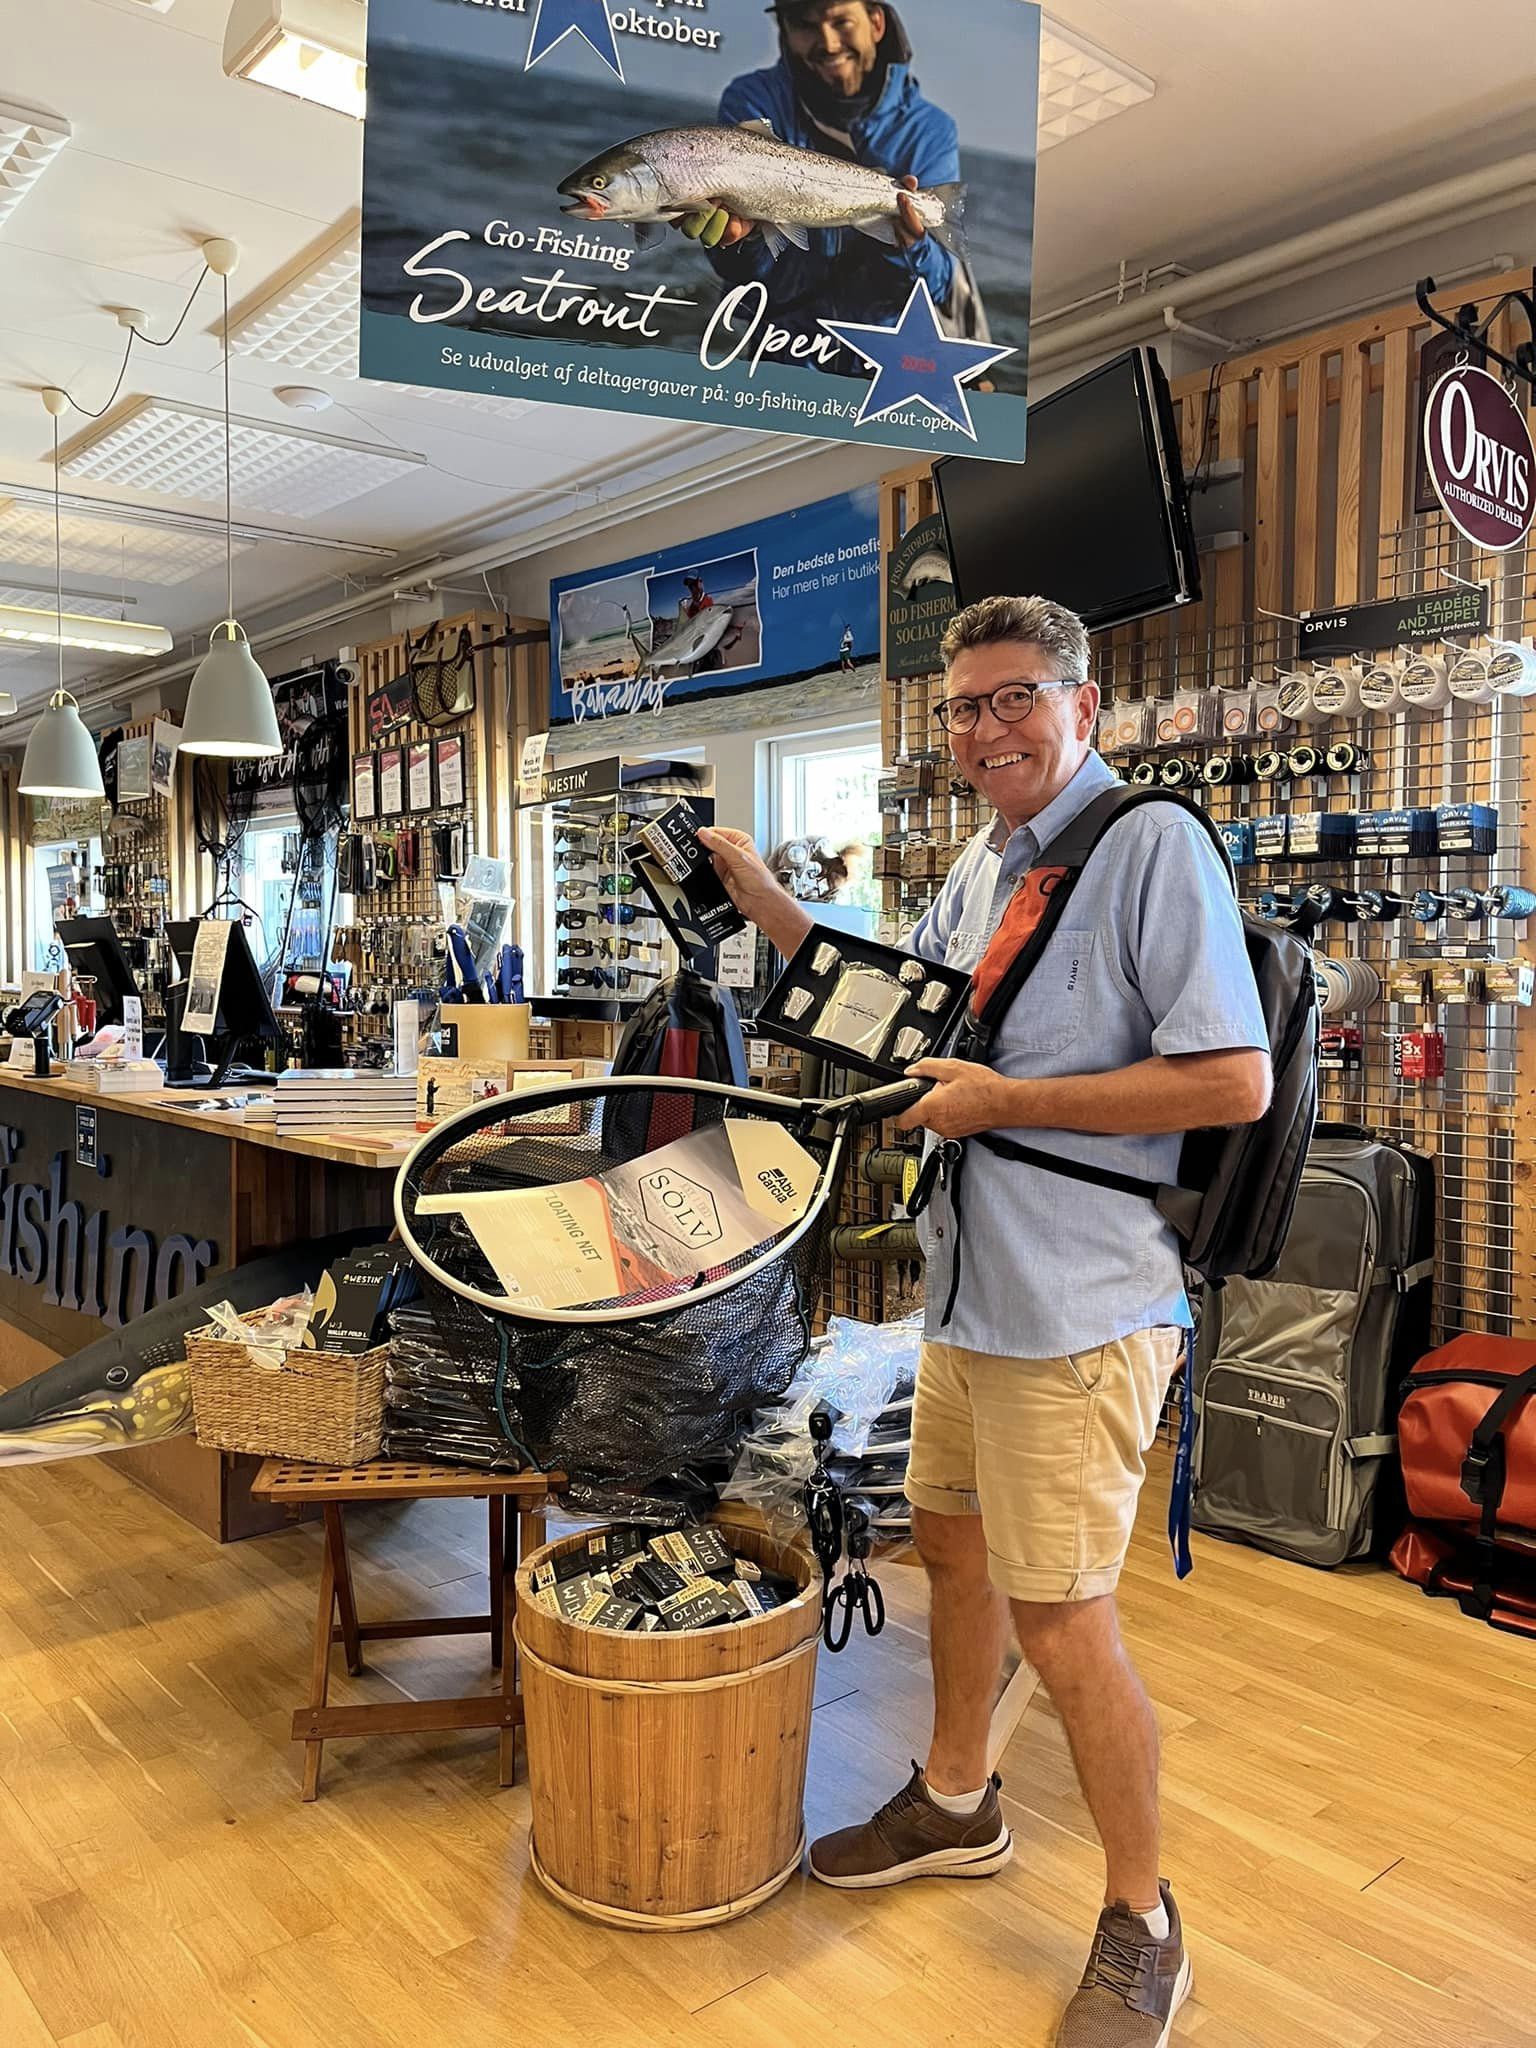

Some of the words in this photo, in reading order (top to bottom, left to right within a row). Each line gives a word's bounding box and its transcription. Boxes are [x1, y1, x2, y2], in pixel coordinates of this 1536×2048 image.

[611, 8, 721, 49] oktober
[483, 219, 634, 272] Go-Fishing
[402, 230, 699, 337] Seatrout
[700, 280, 841, 379] Open
[440, 346, 462, 366] Se
[468, 349, 549, 381] udvalget
[554, 362, 576, 385] af
[577, 364, 699, 399] deltagergaver
[702, 382, 729, 405] på:
[1440, 380, 1529, 512] ORVIS
[1443, 480, 1495, 516] AUTHORIZED
[1495, 504, 1524, 530] DEALER
[902, 528, 937, 562] STORIES
[772, 565, 795, 580] Den
[797, 552, 835, 573] bedste
[792, 578, 820, 595] mere
[821, 571, 840, 588] her
[890, 607, 908, 625] OLD
[1417, 593, 1481, 616] LEADERS
[1304, 617, 1348, 633] ORVIS
[1397, 614, 1432, 632] AND
[1432, 607, 1481, 626] TIPPET
[1411, 628, 1426, 637] Pick
[1426, 626, 1443, 637] your
[1443, 621, 1481, 634] preference
[896, 621, 939, 646] SOCIAL
[548, 773, 588, 794] WESTIN
[1067, 959, 1080, 991] ORVIS
[1393, 1033, 1402, 1076] ORVIS
[757, 1171, 788, 1204] Garcia
[775, 1177, 798, 1198] Abu
[649, 1174, 713, 1237] SÖLV
[575, 1240, 603, 1261] NET
[349, 1274, 382, 1284] WESTIN
[1247, 1388, 1286, 1407] TRAPER
